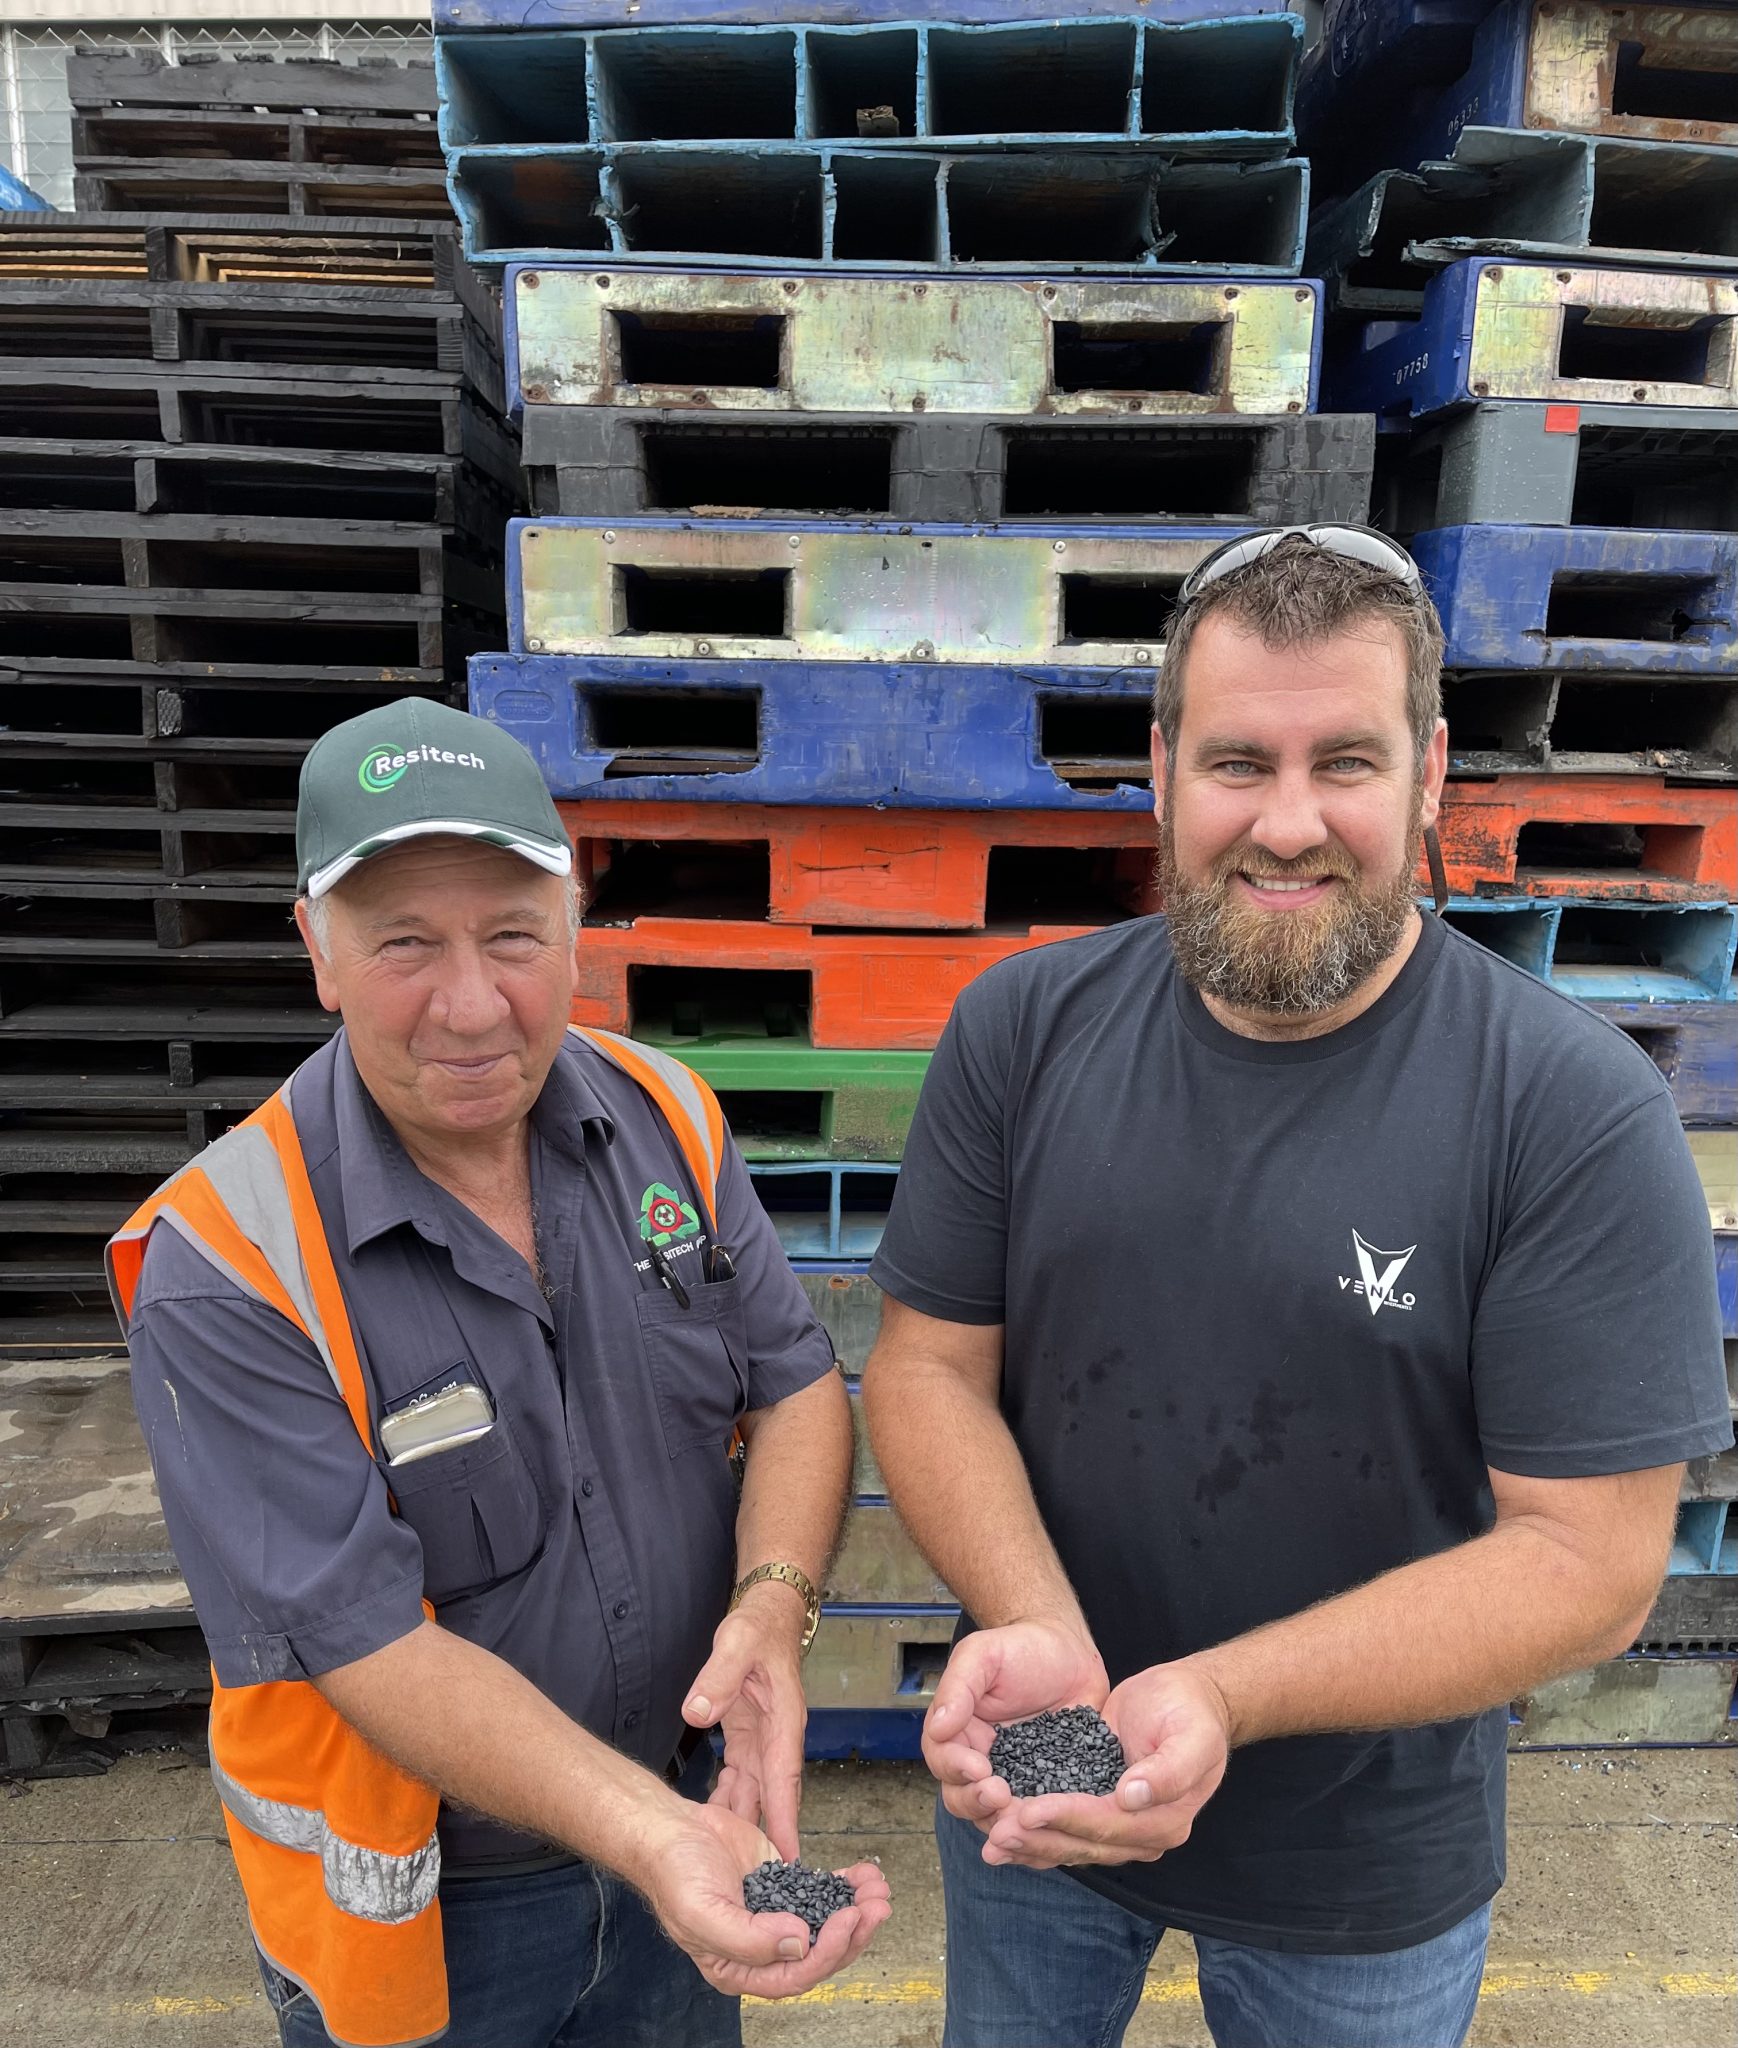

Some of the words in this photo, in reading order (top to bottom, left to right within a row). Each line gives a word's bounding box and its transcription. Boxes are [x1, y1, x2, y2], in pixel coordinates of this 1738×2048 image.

[1396, 353, 1428, 384] 07758
[375, 744, 485, 775] Resitech
[1338, 1275, 1416, 1306] VENLO
